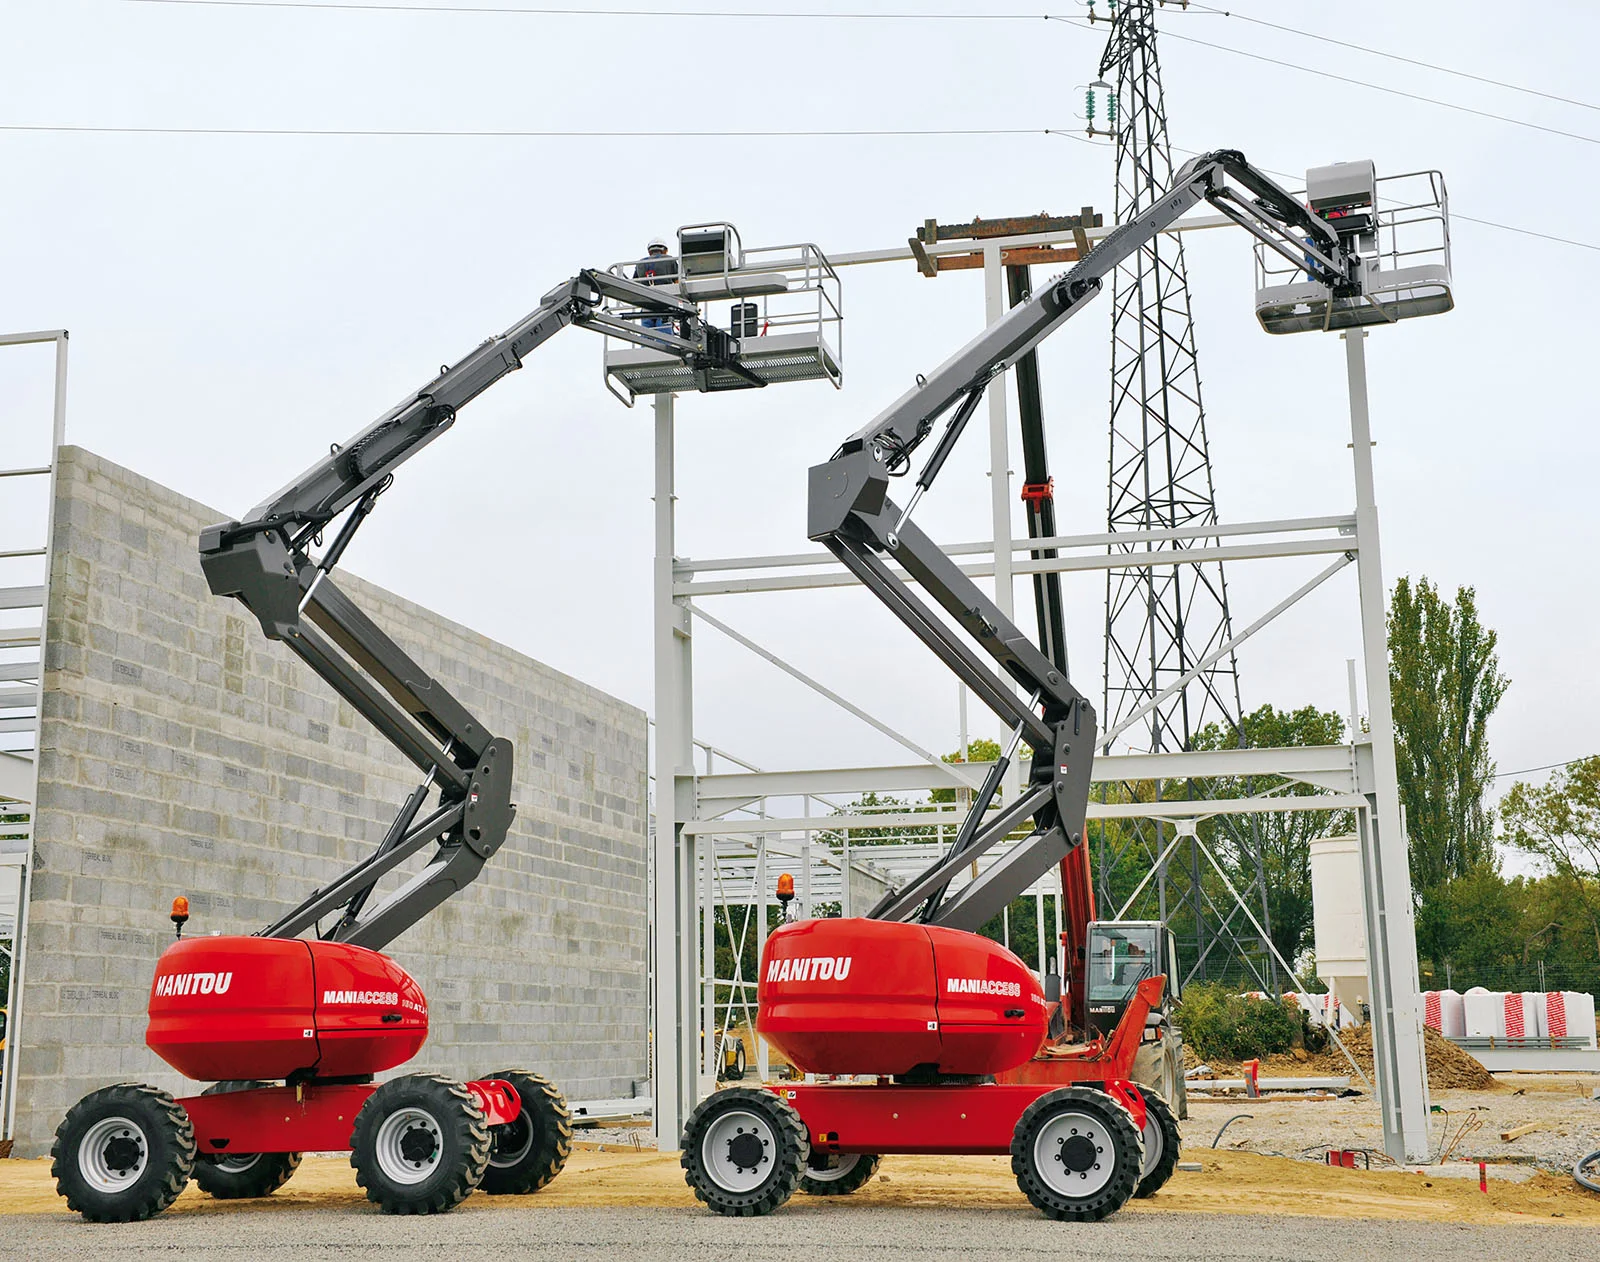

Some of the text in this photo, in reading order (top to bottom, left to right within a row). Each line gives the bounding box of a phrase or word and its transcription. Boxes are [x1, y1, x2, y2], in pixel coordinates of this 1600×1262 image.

[765, 957, 853, 983] MANITOU
[155, 972, 233, 997] MANITOU
[947, 978, 1021, 997] MANIACCESS
[323, 991, 399, 1006] MANIACCESS
